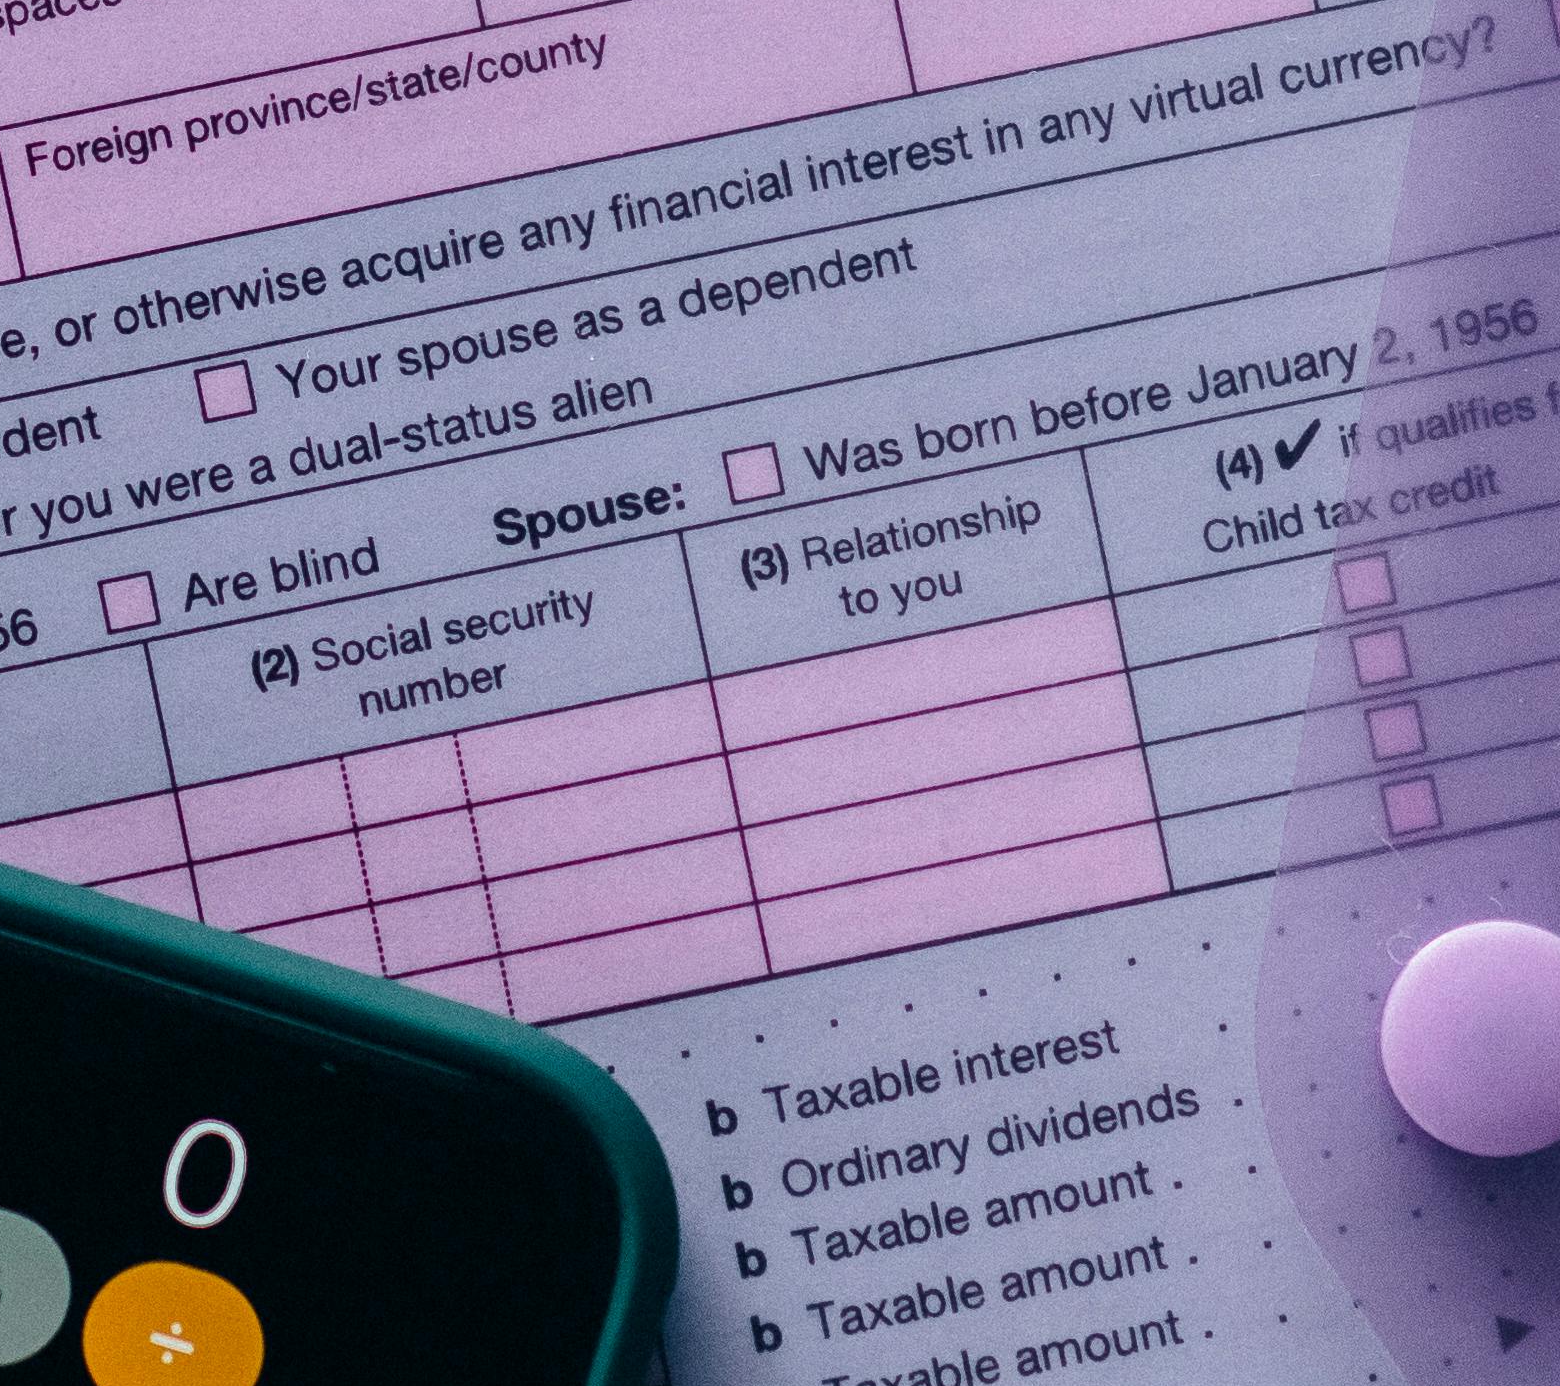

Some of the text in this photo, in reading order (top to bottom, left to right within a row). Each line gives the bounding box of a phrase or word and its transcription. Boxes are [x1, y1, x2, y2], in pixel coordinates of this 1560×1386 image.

[24, 32, 607, 178] Foreign province/state/county
[740, 495, 1042, 592] (3) Relationship
[837, 569, 964, 618] to you
[250, 589, 595, 694] (2) Social security
[358, 663, 507, 718] number
[704, 1018, 1121, 1139] b Taxable interest
[162, 1118, 248, 1229] 0
[719, 1082, 1201, 1212] b Ordinary dividends
